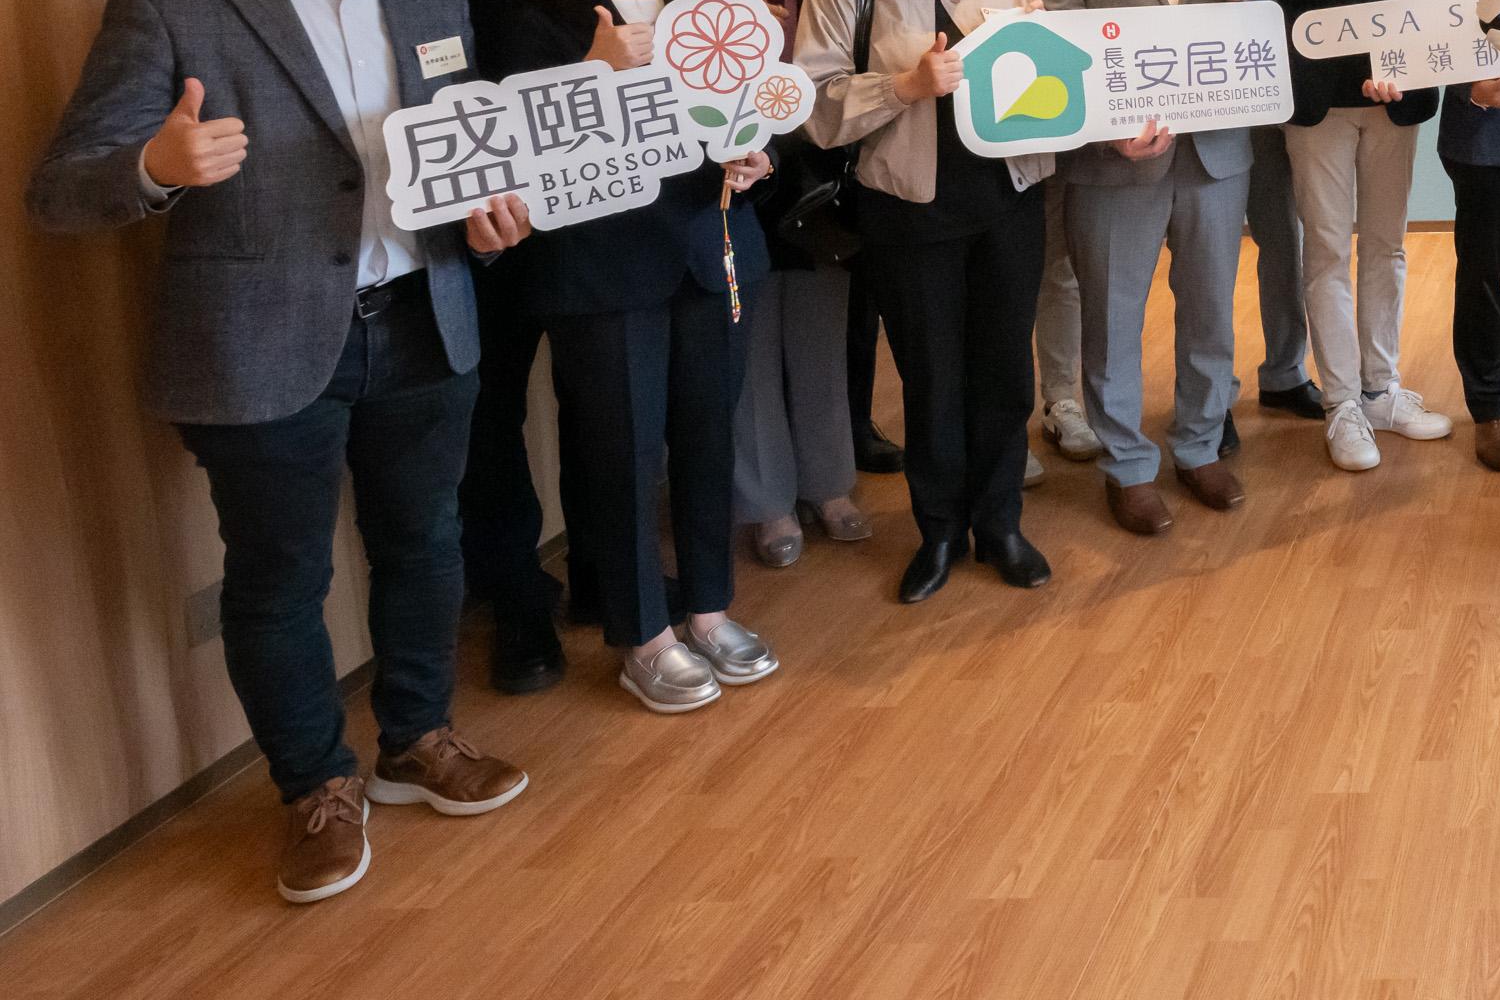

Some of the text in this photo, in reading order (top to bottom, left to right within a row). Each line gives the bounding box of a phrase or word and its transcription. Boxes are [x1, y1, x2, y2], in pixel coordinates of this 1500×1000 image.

[1304, 9, 1421, 45] CASA
[1103, 47, 1128, 93] 長者
[1134, 38, 1277, 91] 安居樂
[1379, 37, 1500, 79] 樂嶺都
[1108, 85, 1280, 111] SENIOR CITIZEN RESIDENCES
[1164, 112, 1189, 122] HONG
[1190, 109, 1213, 119] KONG
[1214, 106, 1250, 117] HOUSING
[1250, 102, 1282, 113] SOCIETY
[403, 74, 680, 214] 盛頤居
[538, 142, 689, 192] BLOSSOM
[544, 174, 645, 216] PLACE
